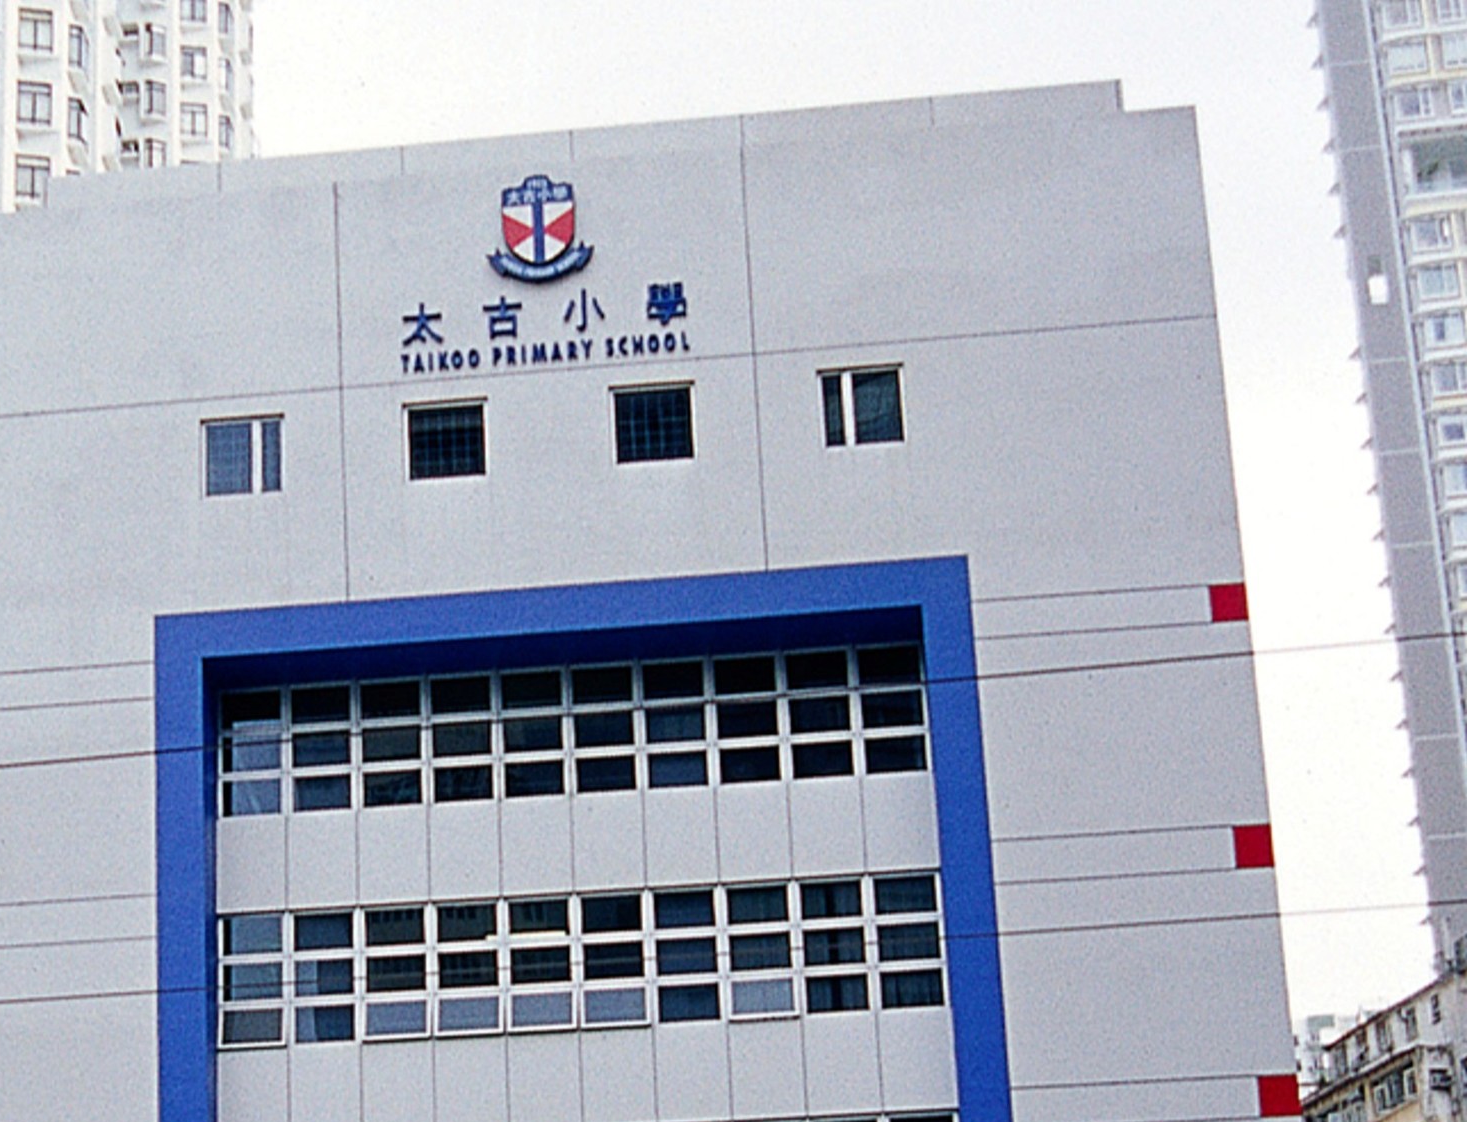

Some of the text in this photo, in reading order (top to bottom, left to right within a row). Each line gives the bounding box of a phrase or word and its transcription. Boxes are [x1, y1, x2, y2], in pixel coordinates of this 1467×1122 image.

[402, 281, 687, 347] 太古小學
[401, 330, 691, 374] TAIKOO PRIMARY SCHOOL
